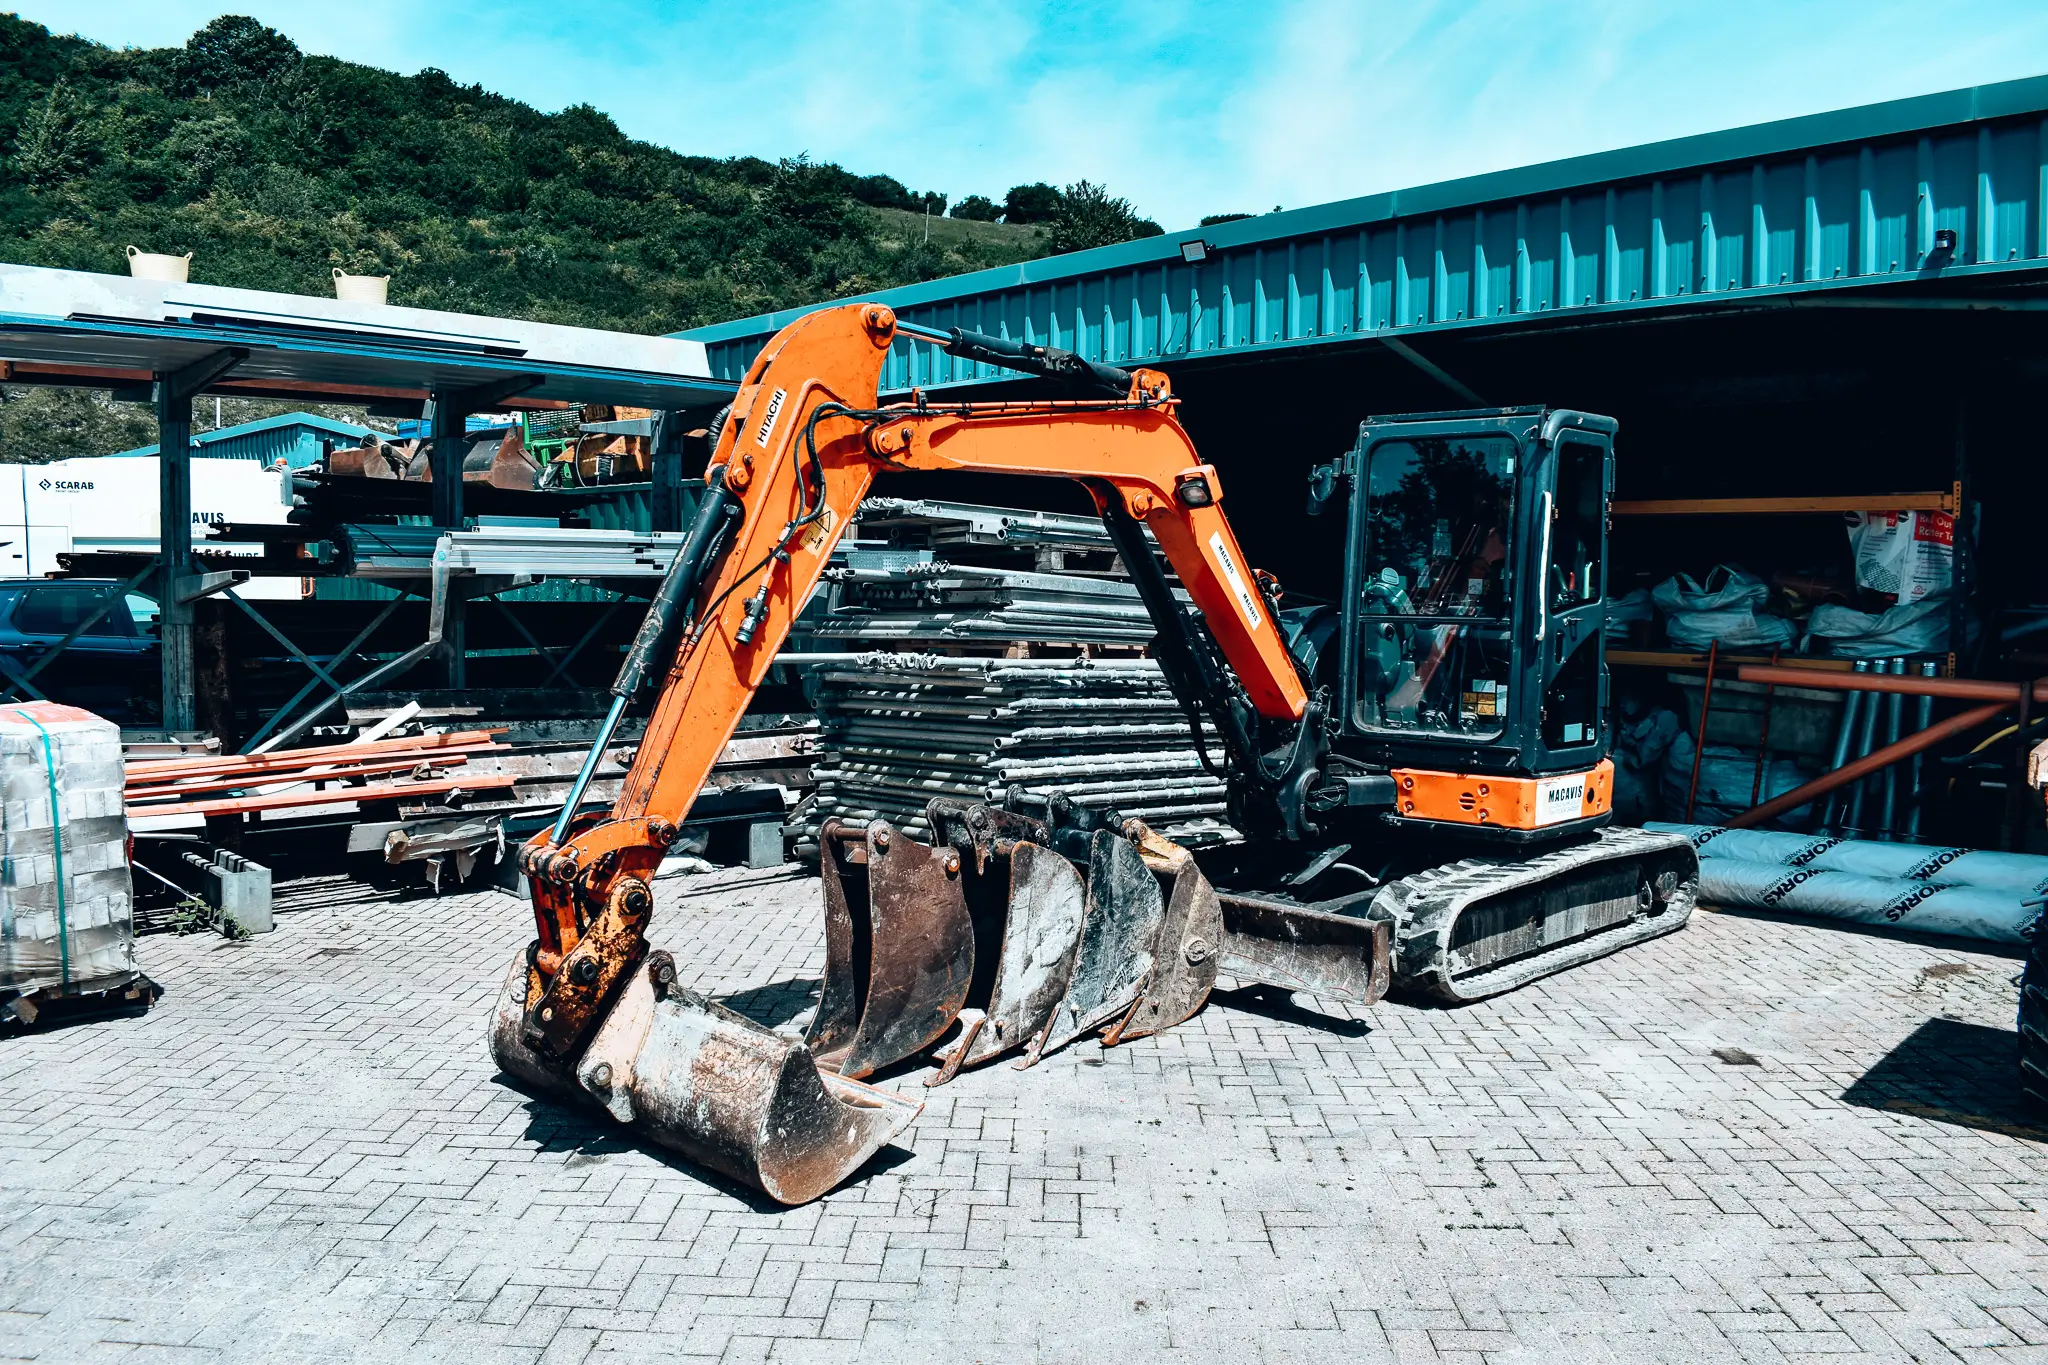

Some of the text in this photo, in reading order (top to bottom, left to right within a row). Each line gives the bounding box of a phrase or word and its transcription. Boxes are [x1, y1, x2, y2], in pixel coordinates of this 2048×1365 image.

[757, 390, 783, 442] HITACHI
[55, 480, 95, 490] SCARAB
[191, 512, 224, 523] AVIS
[1936, 516, 1952, 530] Out
[1218, 545, 1234, 574] MACAVIS
[1243, 593, 1258, 621] MACAVIS
[1549, 785, 1583, 802] MACAVIS
[1900, 858, 1928, 880] WREKIN
[1756, 876, 1784, 898] WREKIN
[1879, 891, 1909, 913] WREKIN
